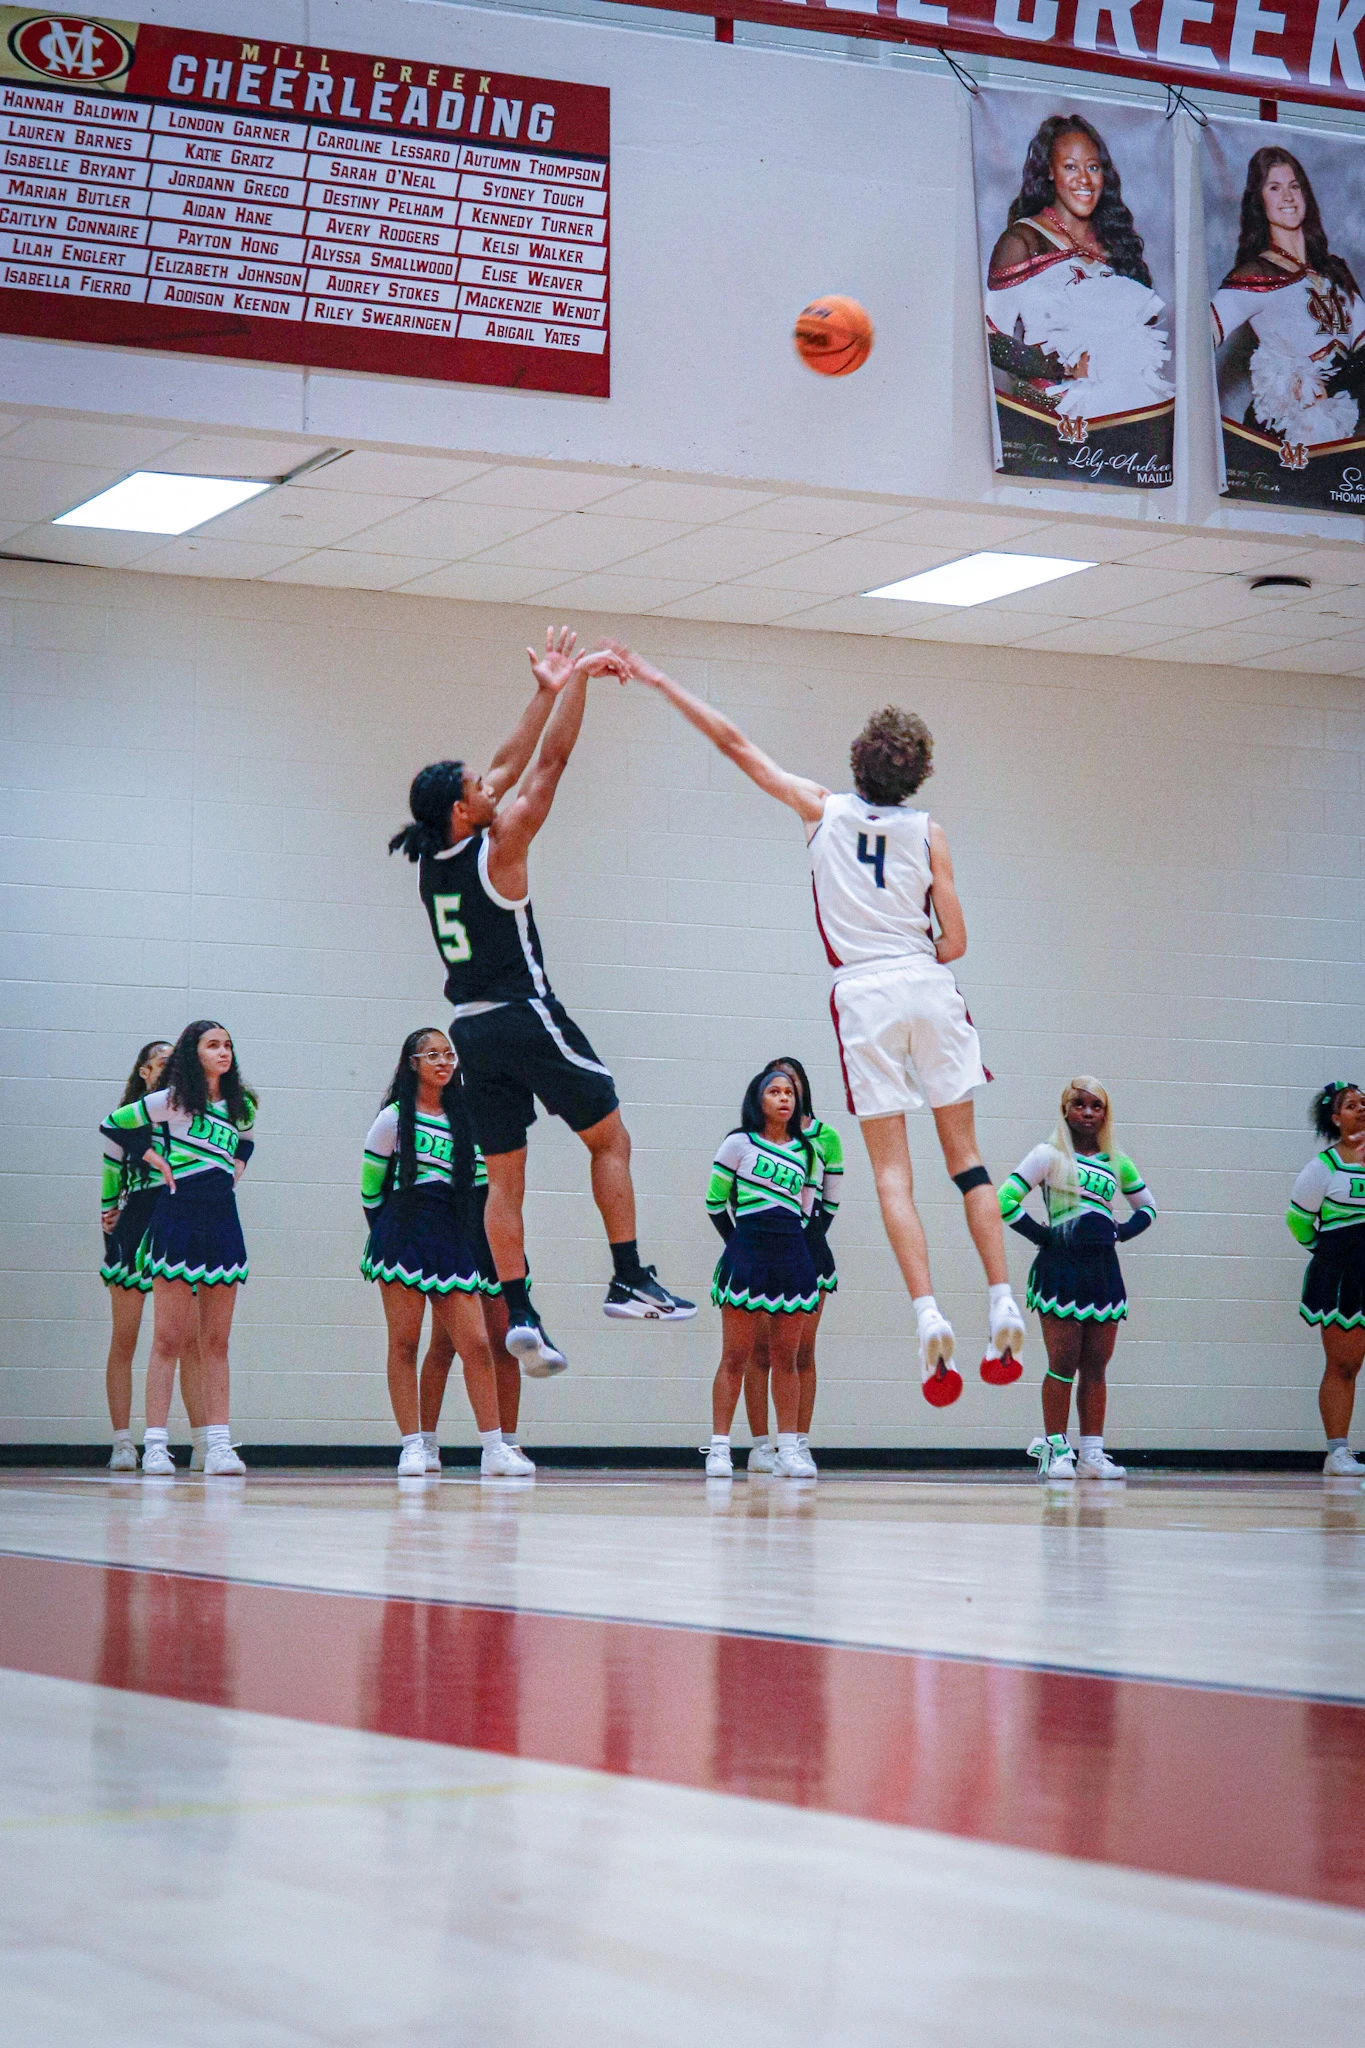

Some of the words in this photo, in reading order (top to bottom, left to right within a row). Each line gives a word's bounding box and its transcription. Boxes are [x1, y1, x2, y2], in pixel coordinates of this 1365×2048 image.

[240, 43, 330, 72] MILL
[372, 62, 491, 94] CREEK
[4, 90, 64, 113] HANNAH
[73, 100, 139, 123] BALDWIN
[167, 54, 556, 143] CHEERLEADING
[8, 121, 65, 143] LAUREN
[74, 129, 133, 151] BARNES
[168, 111, 225, 134] LONDON
[233, 121, 290, 142] GARNER
[185, 143, 223, 162] KATIE
[231, 149, 275, 169] GRATZ
[317, 131, 383, 154] CAROLINE
[391, 141, 451, 163] LESSARD
[4, 149, 70, 173] ISABELLE
[80, 159, 136, 181] BRYANT
[330, 161, 377, 181] SARAH
[385, 168, 436, 189] O'NEAL
[463, 150, 521, 172] AUTUMN
[529, 159, 601, 182] THOMPSON
[7, 179, 68, 202] MARIAH
[76, 187, 131, 209] BUTLER
[168, 170, 235, 192] JORDANN
[244, 179, 290, 199] GRECO
[483, 181, 535, 202] SYDNEY
[543, 189, 585, 208] TOUCH
[182, 200, 226, 220] AIDAN
[235, 206, 273, 226] HANE
[323, 188, 380, 210] DESTINY
[388, 197, 444, 219] PELHAM
[0, 207, 57, 230] CAITLYN
[66, 216, 140, 240] CONNAIRE
[326, 217, 371, 238] AVERY
[379, 224, 440, 246] RODGERS
[472, 207, 534, 230] KENNEDY
[541, 216, 594, 238] TURNER
[12, 238, 53, 258] LILAH
[61, 244, 126, 267] ENGLERT
[178, 228, 232, 250] PAYTON
[241, 235, 279, 255] HONG
[482, 236, 520, 256] KELSI
[529, 242, 584, 264] WALKER
[155, 256, 229, 279] ELIZABETH
[237, 265, 302, 287] JOHNSON
[311, 244, 361, 265] ALYSSA
[371, 252, 454, 276] SMALLWOOD
[4, 267, 70, 289] ISABELLA
[80, 275, 131, 296] FIERRO
[326, 275, 380, 296] AUDREY
[388, 282, 440, 303] STOKES
[481, 265, 518, 284] ELISE
[528, 270, 583, 292] WEAVER
[164, 285, 225, 308] ADDISON
[233, 293, 290, 315] KEENON
[464, 290, 543, 315] MACKENZIE
[552, 301, 601, 321] WENDT
[314, 302, 354, 321] RILEY
[361, 308, 452, 332] SWEARINGEN
[485, 321, 535, 342] ABIGAIL
[544, 328, 581, 347] YATES
[857, 832, 886, 889] 4
[433, 893, 473, 963] 5
[414, 1129, 454, 1163] DH
[752, 1153, 805, 1196] DHS
